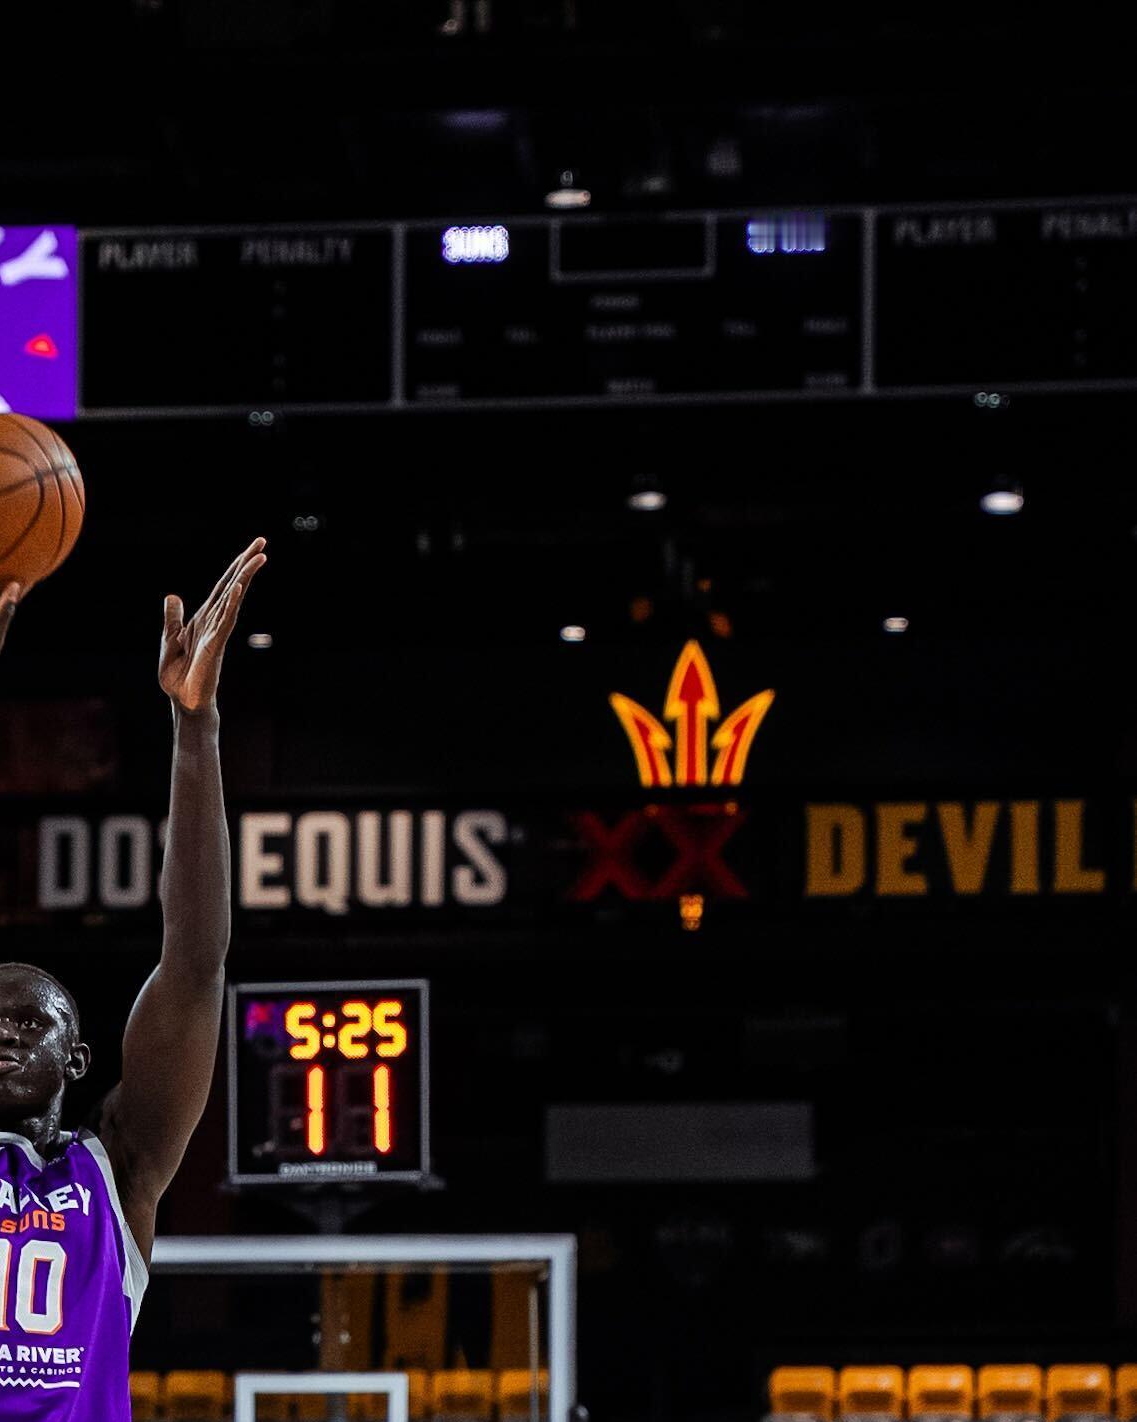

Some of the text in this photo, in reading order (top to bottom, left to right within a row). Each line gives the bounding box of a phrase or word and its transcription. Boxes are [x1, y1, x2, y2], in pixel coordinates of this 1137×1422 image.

[893, 214, 997, 246] PLAYER
[97, 240, 198, 271] PLAYER
[37, 810, 507, 914] DO EQUIS
[804, 800, 1106, 897] DEVIL
[284, 1000, 408, 1060] 5:25
[30, 1366, 82, 1376] CASINOS
